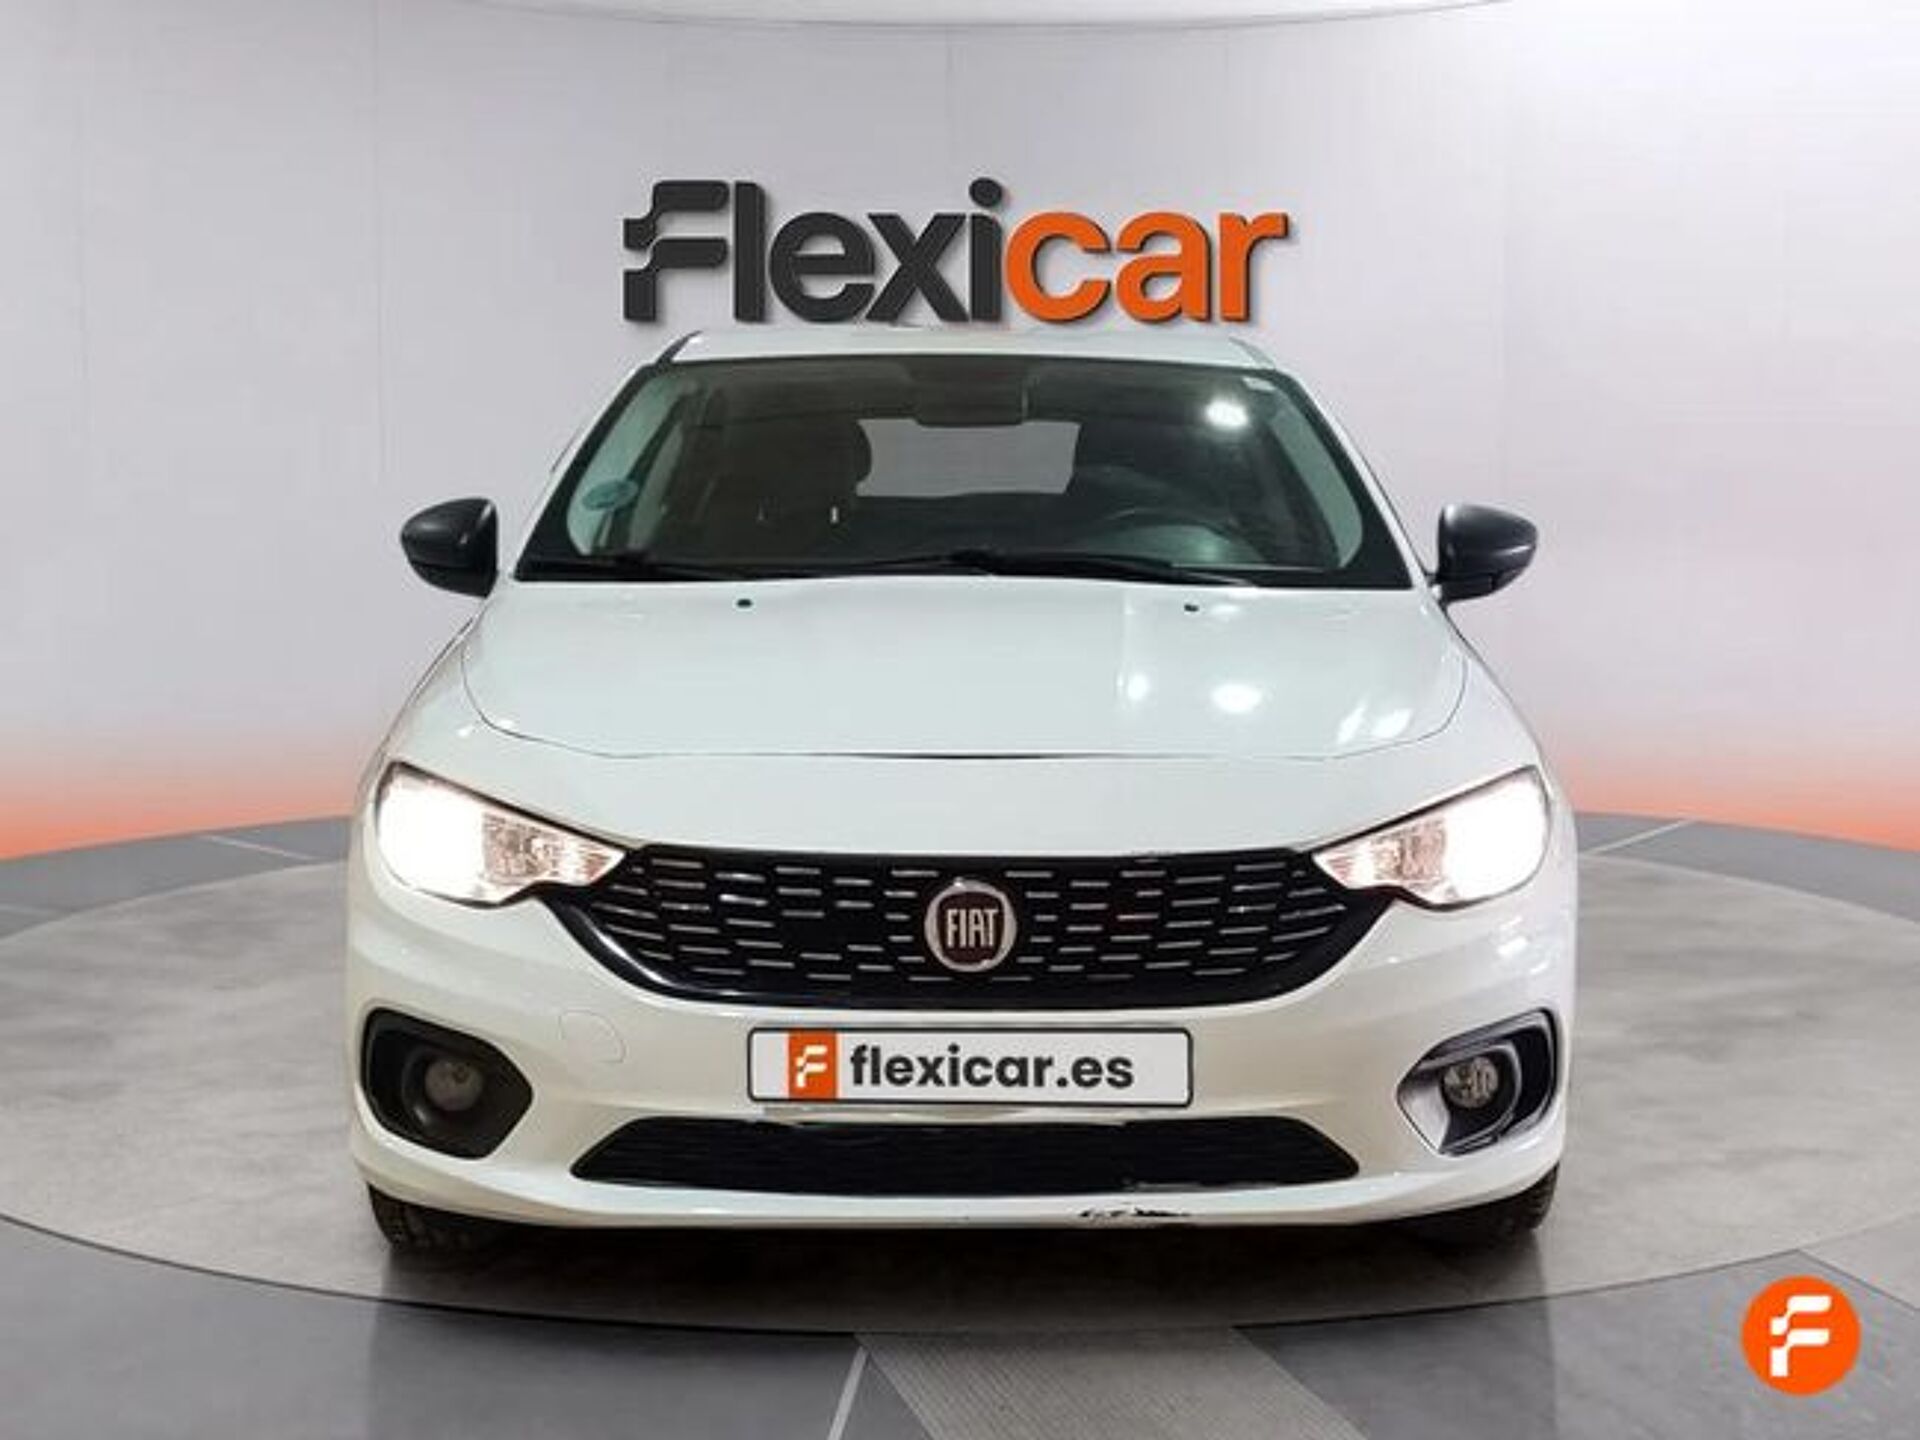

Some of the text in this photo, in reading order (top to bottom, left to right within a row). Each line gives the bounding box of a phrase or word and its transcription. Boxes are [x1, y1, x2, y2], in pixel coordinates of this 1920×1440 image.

[623, 177, 1291, 325] Flexicar
[946, 908, 999, 948] FIAT
[850, 1044, 1135, 1089] flexicar.es
